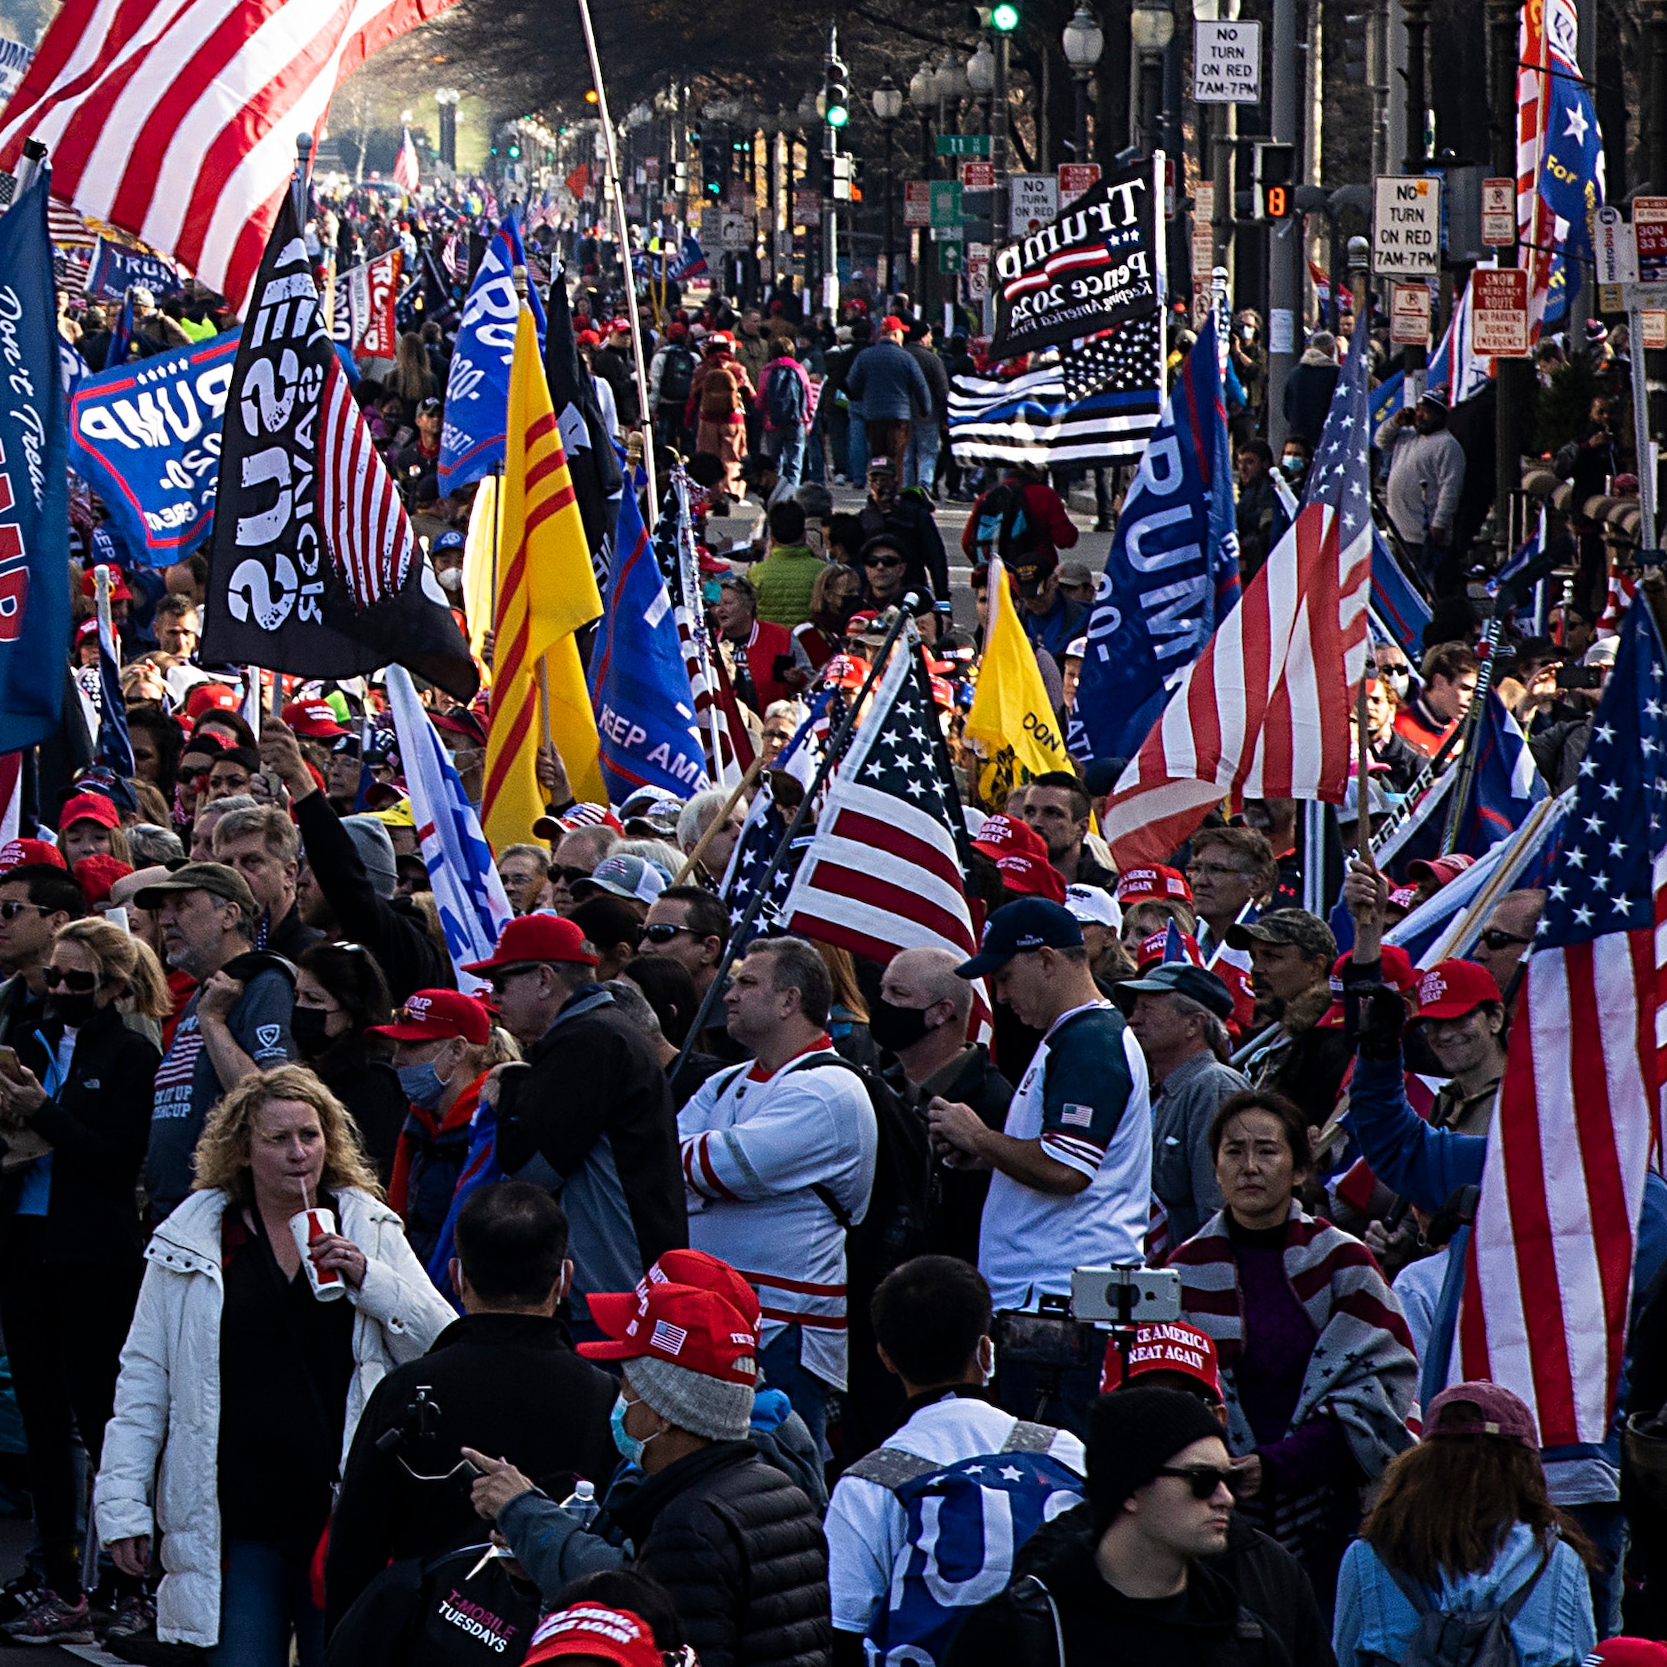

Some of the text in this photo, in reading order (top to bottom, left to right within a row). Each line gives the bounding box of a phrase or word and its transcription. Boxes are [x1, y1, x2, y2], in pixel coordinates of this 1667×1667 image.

[1217, 28, 1238, 41] NO
[1210, 46, 1245, 59] TURN
[1201, 64, 1253, 77] ON RED
[1197, 81, 1257, 95] 7AM-7PM
[950, 139, 964, 152] 11
[1024, 181, 1045, 192] NO
[1397, 186, 1417, 200] NO
[1021, 195, 1049, 205] TURN
[1015, 208, 1054, 216] ON RED
[1389, 207, 1424, 223] TURN
[1638, 225, 1664, 236] 30N
[1380, 230, 1432, 245] ON RED
[1376, 251, 1436, 267] 7AM-7PM
[1604, 226, 1615, 282] metrobus
[1485, 274, 1515, 286] SNOW
[1478, 287, 1522, 297] EMERGENCY
[1485, 296, 1514, 309] ROUTE
[1479, 312, 1522, 322] NO PARKING
[1485, 324, 1516, 334] DURING
[1477, 336, 1522, 347] EMERGENCY
[598, 703, 648, 747] KEEP
[175, 1085, 193, 1102] UP
[1152, 1324, 1211, 1354] AMERICA
[1164, 1347, 1205, 1371] AGAIN
[446, 1589, 517, 1641] T-MOBILE
[437, 1599, 508, 1653] TUESDAYS
